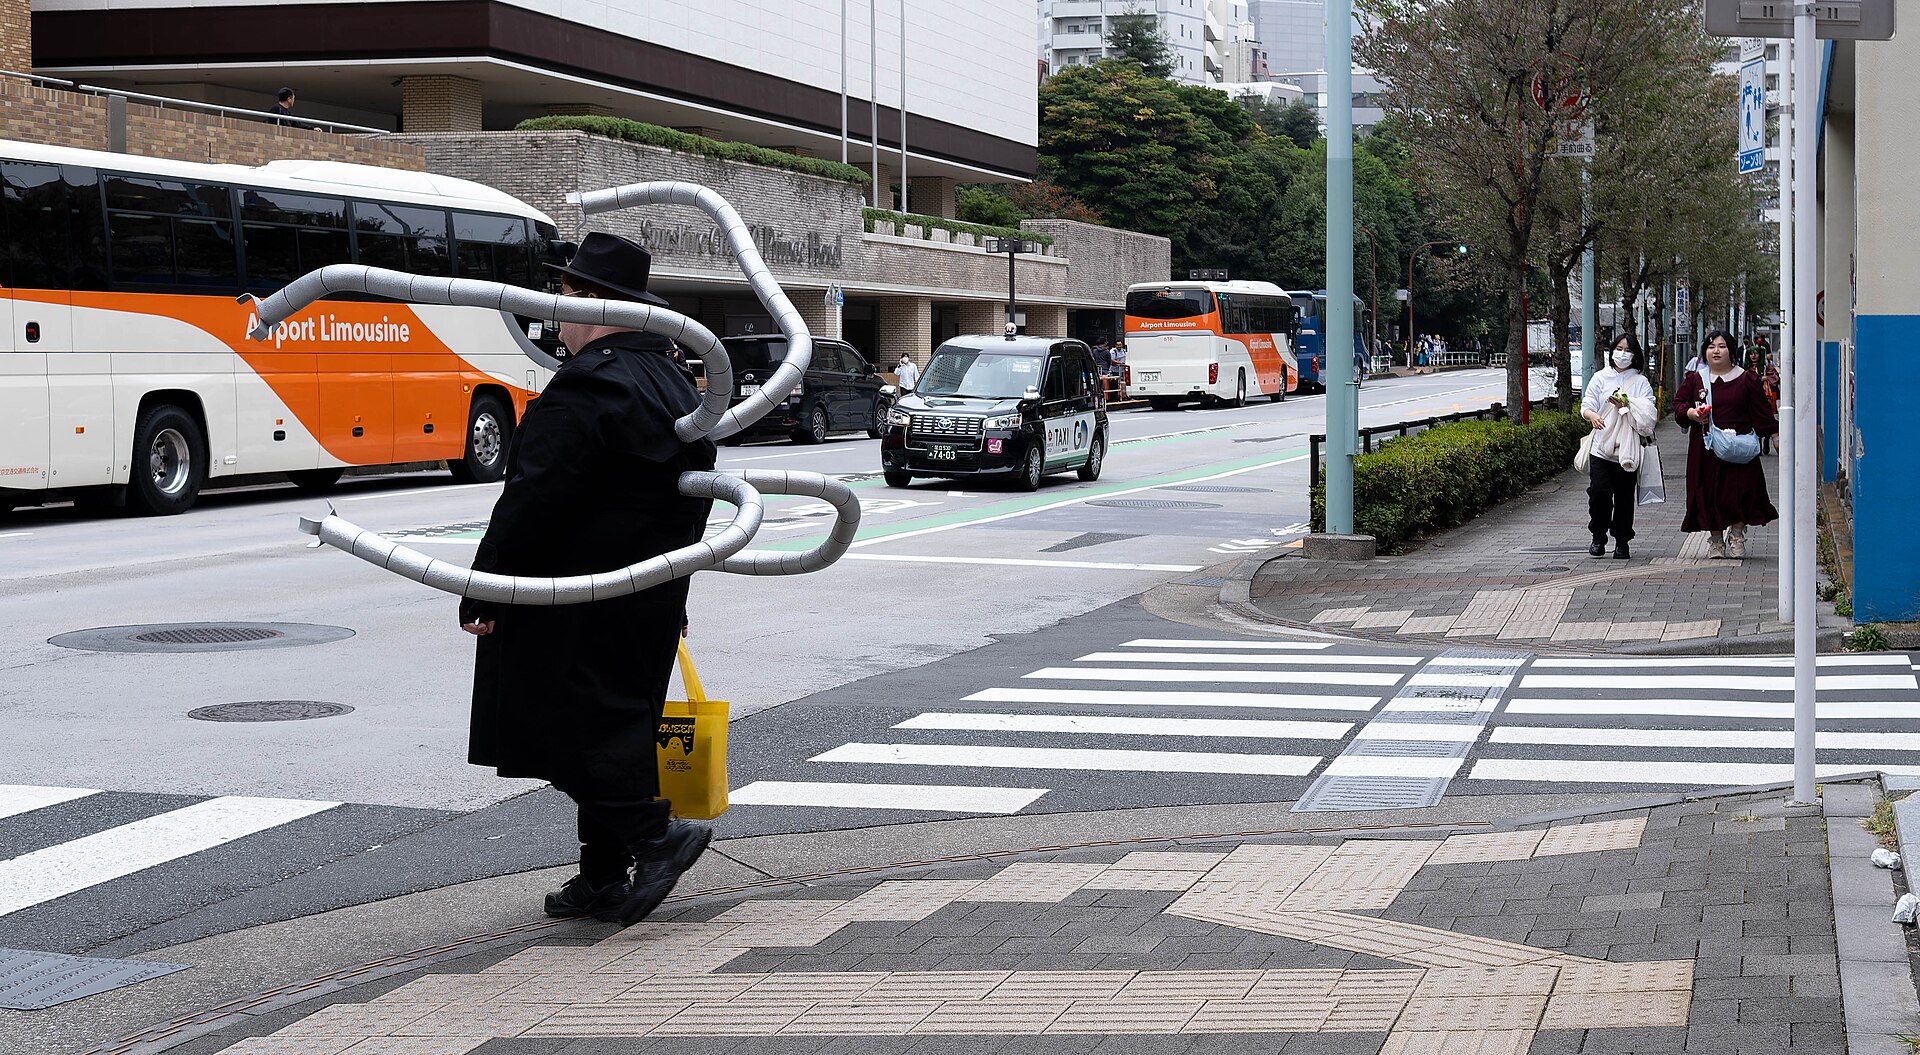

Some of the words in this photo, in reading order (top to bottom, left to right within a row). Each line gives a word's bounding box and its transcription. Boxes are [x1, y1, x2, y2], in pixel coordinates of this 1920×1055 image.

[1560, 143, 1593, 154] 手前曲る
[1740, 152, 1762, 170] ゾーン30
[640, 218, 708, 255] Sunshine
[762, 225, 808, 264] Prince
[244, 312, 316, 349] Aport
[319, 313, 410, 342] Limousine
[1140, 321, 1163, 330] Airport
[1163, 320, 1197, 329] Limousine
[555, 346, 566, 357] 635
[1054, 427, 1069, 447] TAXI
[658, 723, 696, 734] OWEEN
